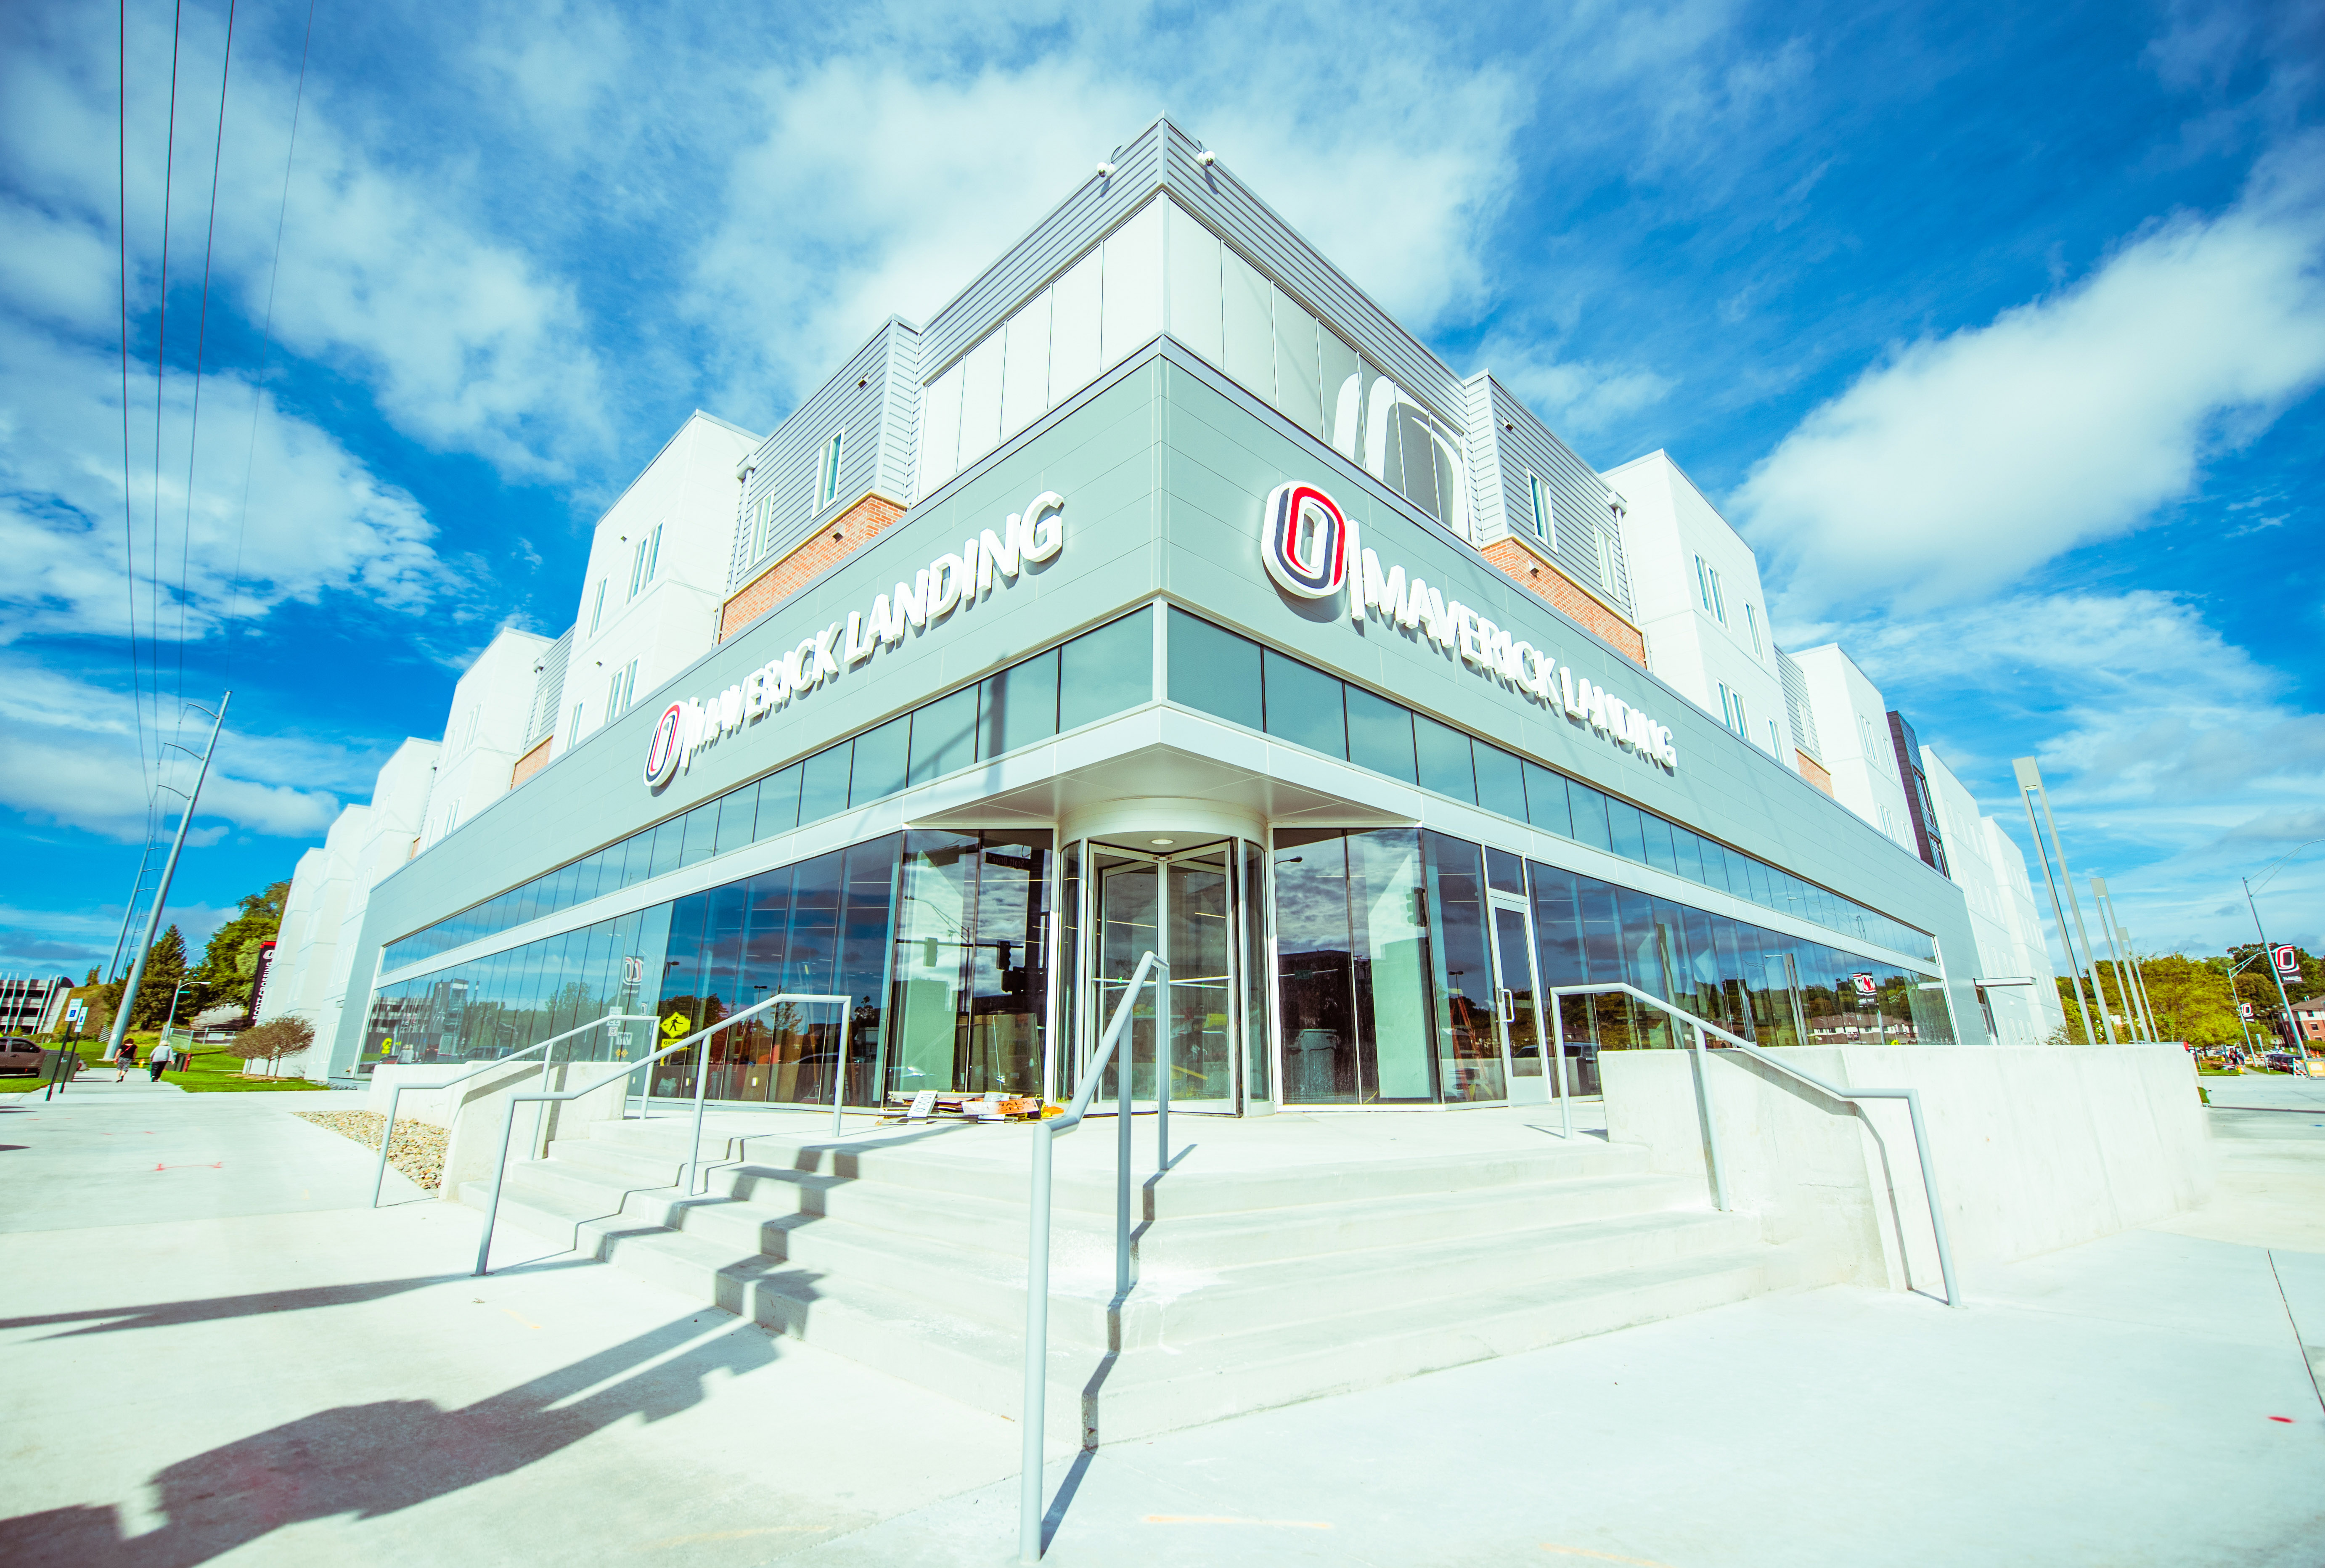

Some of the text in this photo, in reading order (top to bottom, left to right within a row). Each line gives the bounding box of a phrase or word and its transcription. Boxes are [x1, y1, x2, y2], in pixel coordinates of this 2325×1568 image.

[690, 621, 842, 750] MAVERICK
[843, 490, 1064, 664] LANDING
[1261, 479, 1677, 767] O MAVERICK LANDING
